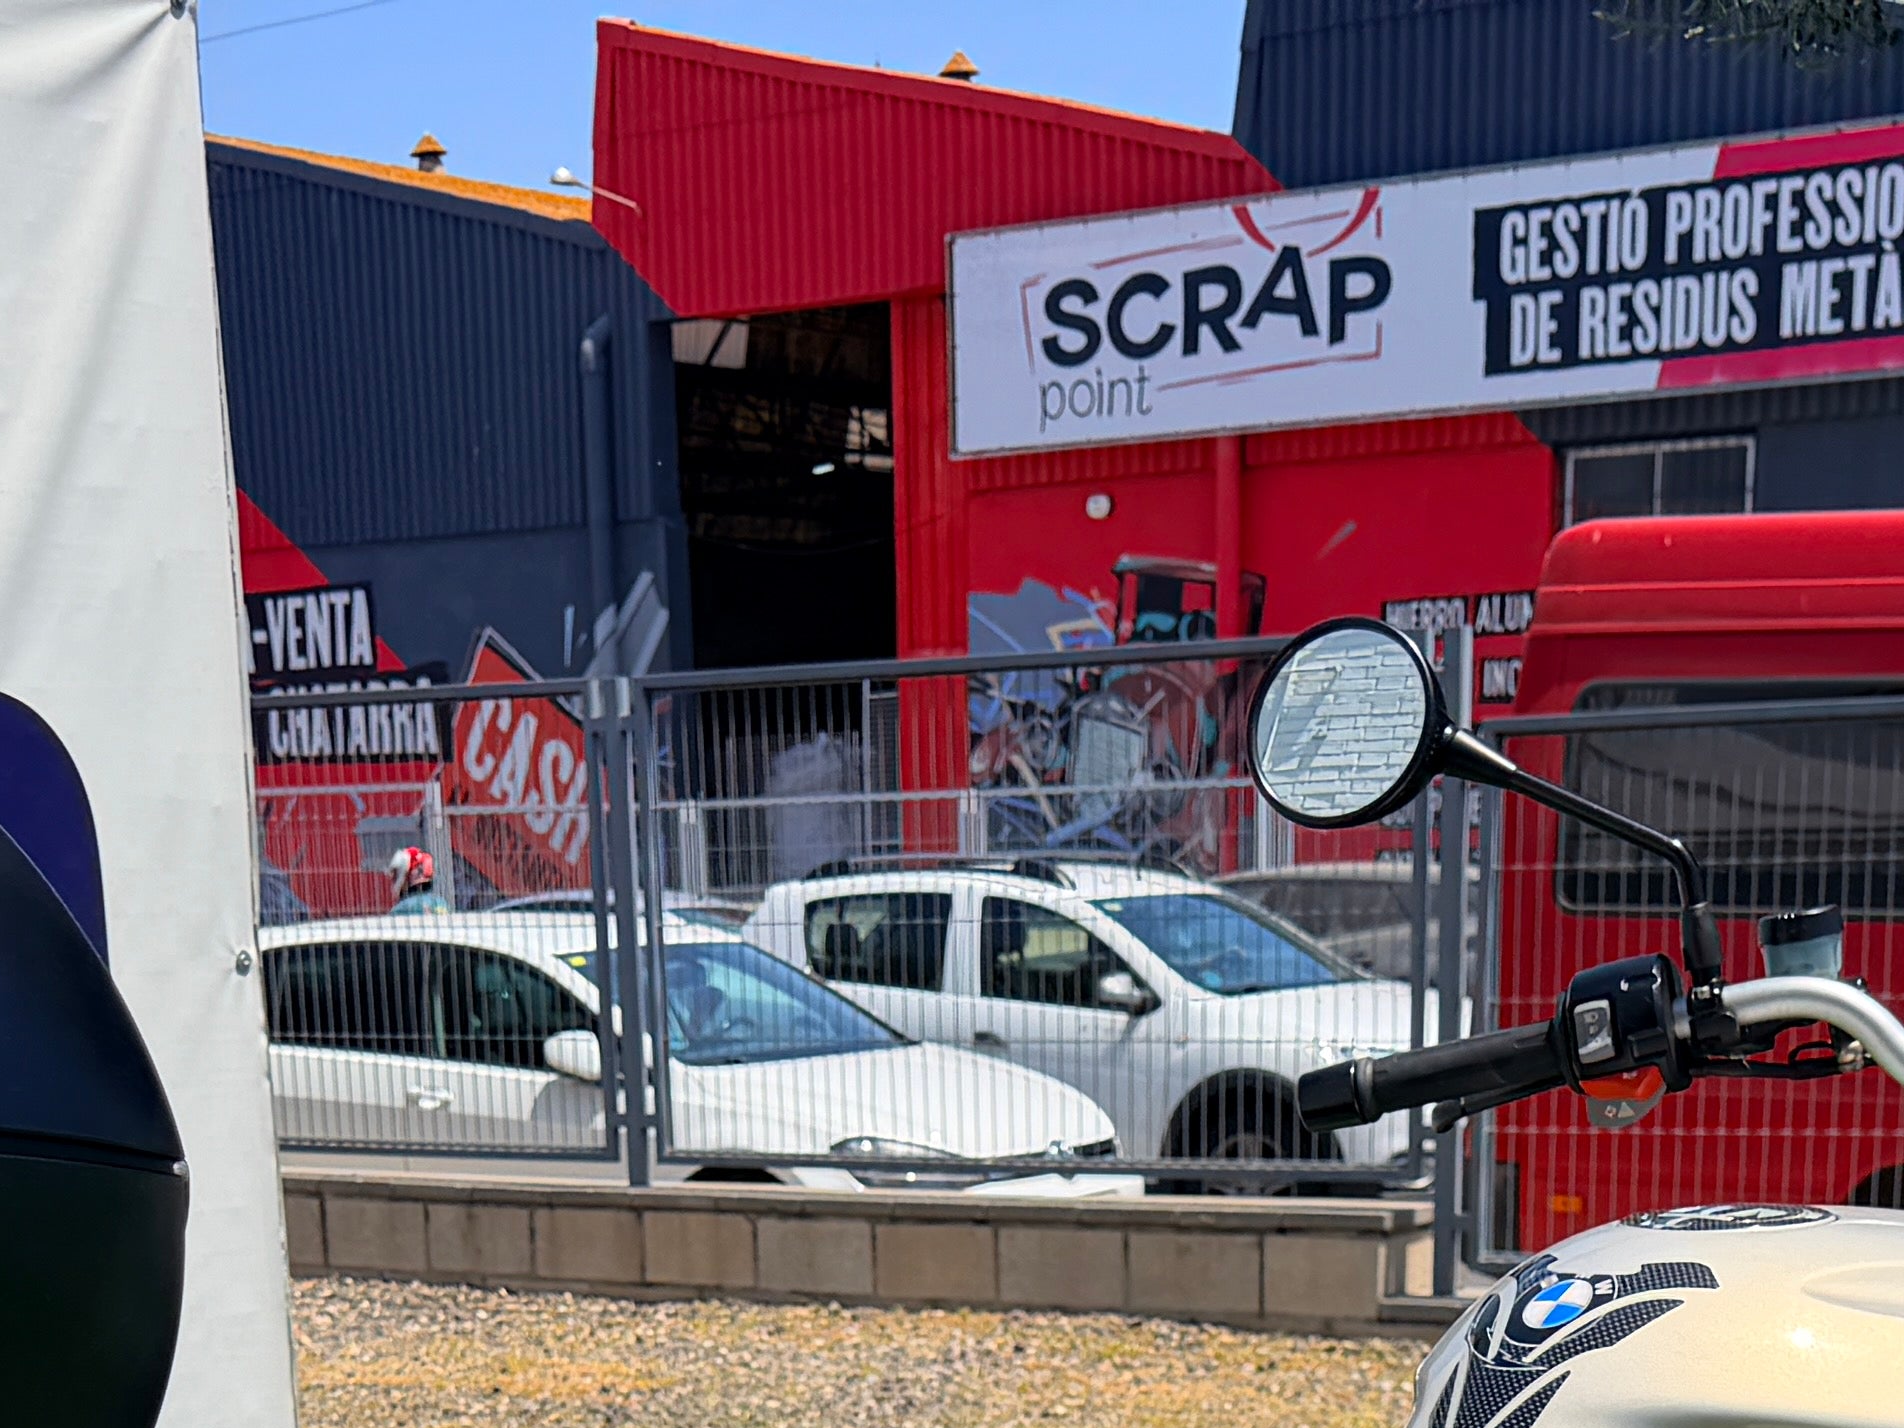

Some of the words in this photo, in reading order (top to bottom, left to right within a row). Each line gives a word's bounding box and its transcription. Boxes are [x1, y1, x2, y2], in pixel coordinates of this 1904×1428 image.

[1499, 188, 1649, 286] GESTIÓ
[1042, 245, 1392, 368] SCRAP
[1509, 290, 1564, 367] DE
[1578, 267, 1760, 360] RESIDUS
[1040, 366, 1153, 433] point
[268, 676, 441, 757] CHATARRA
